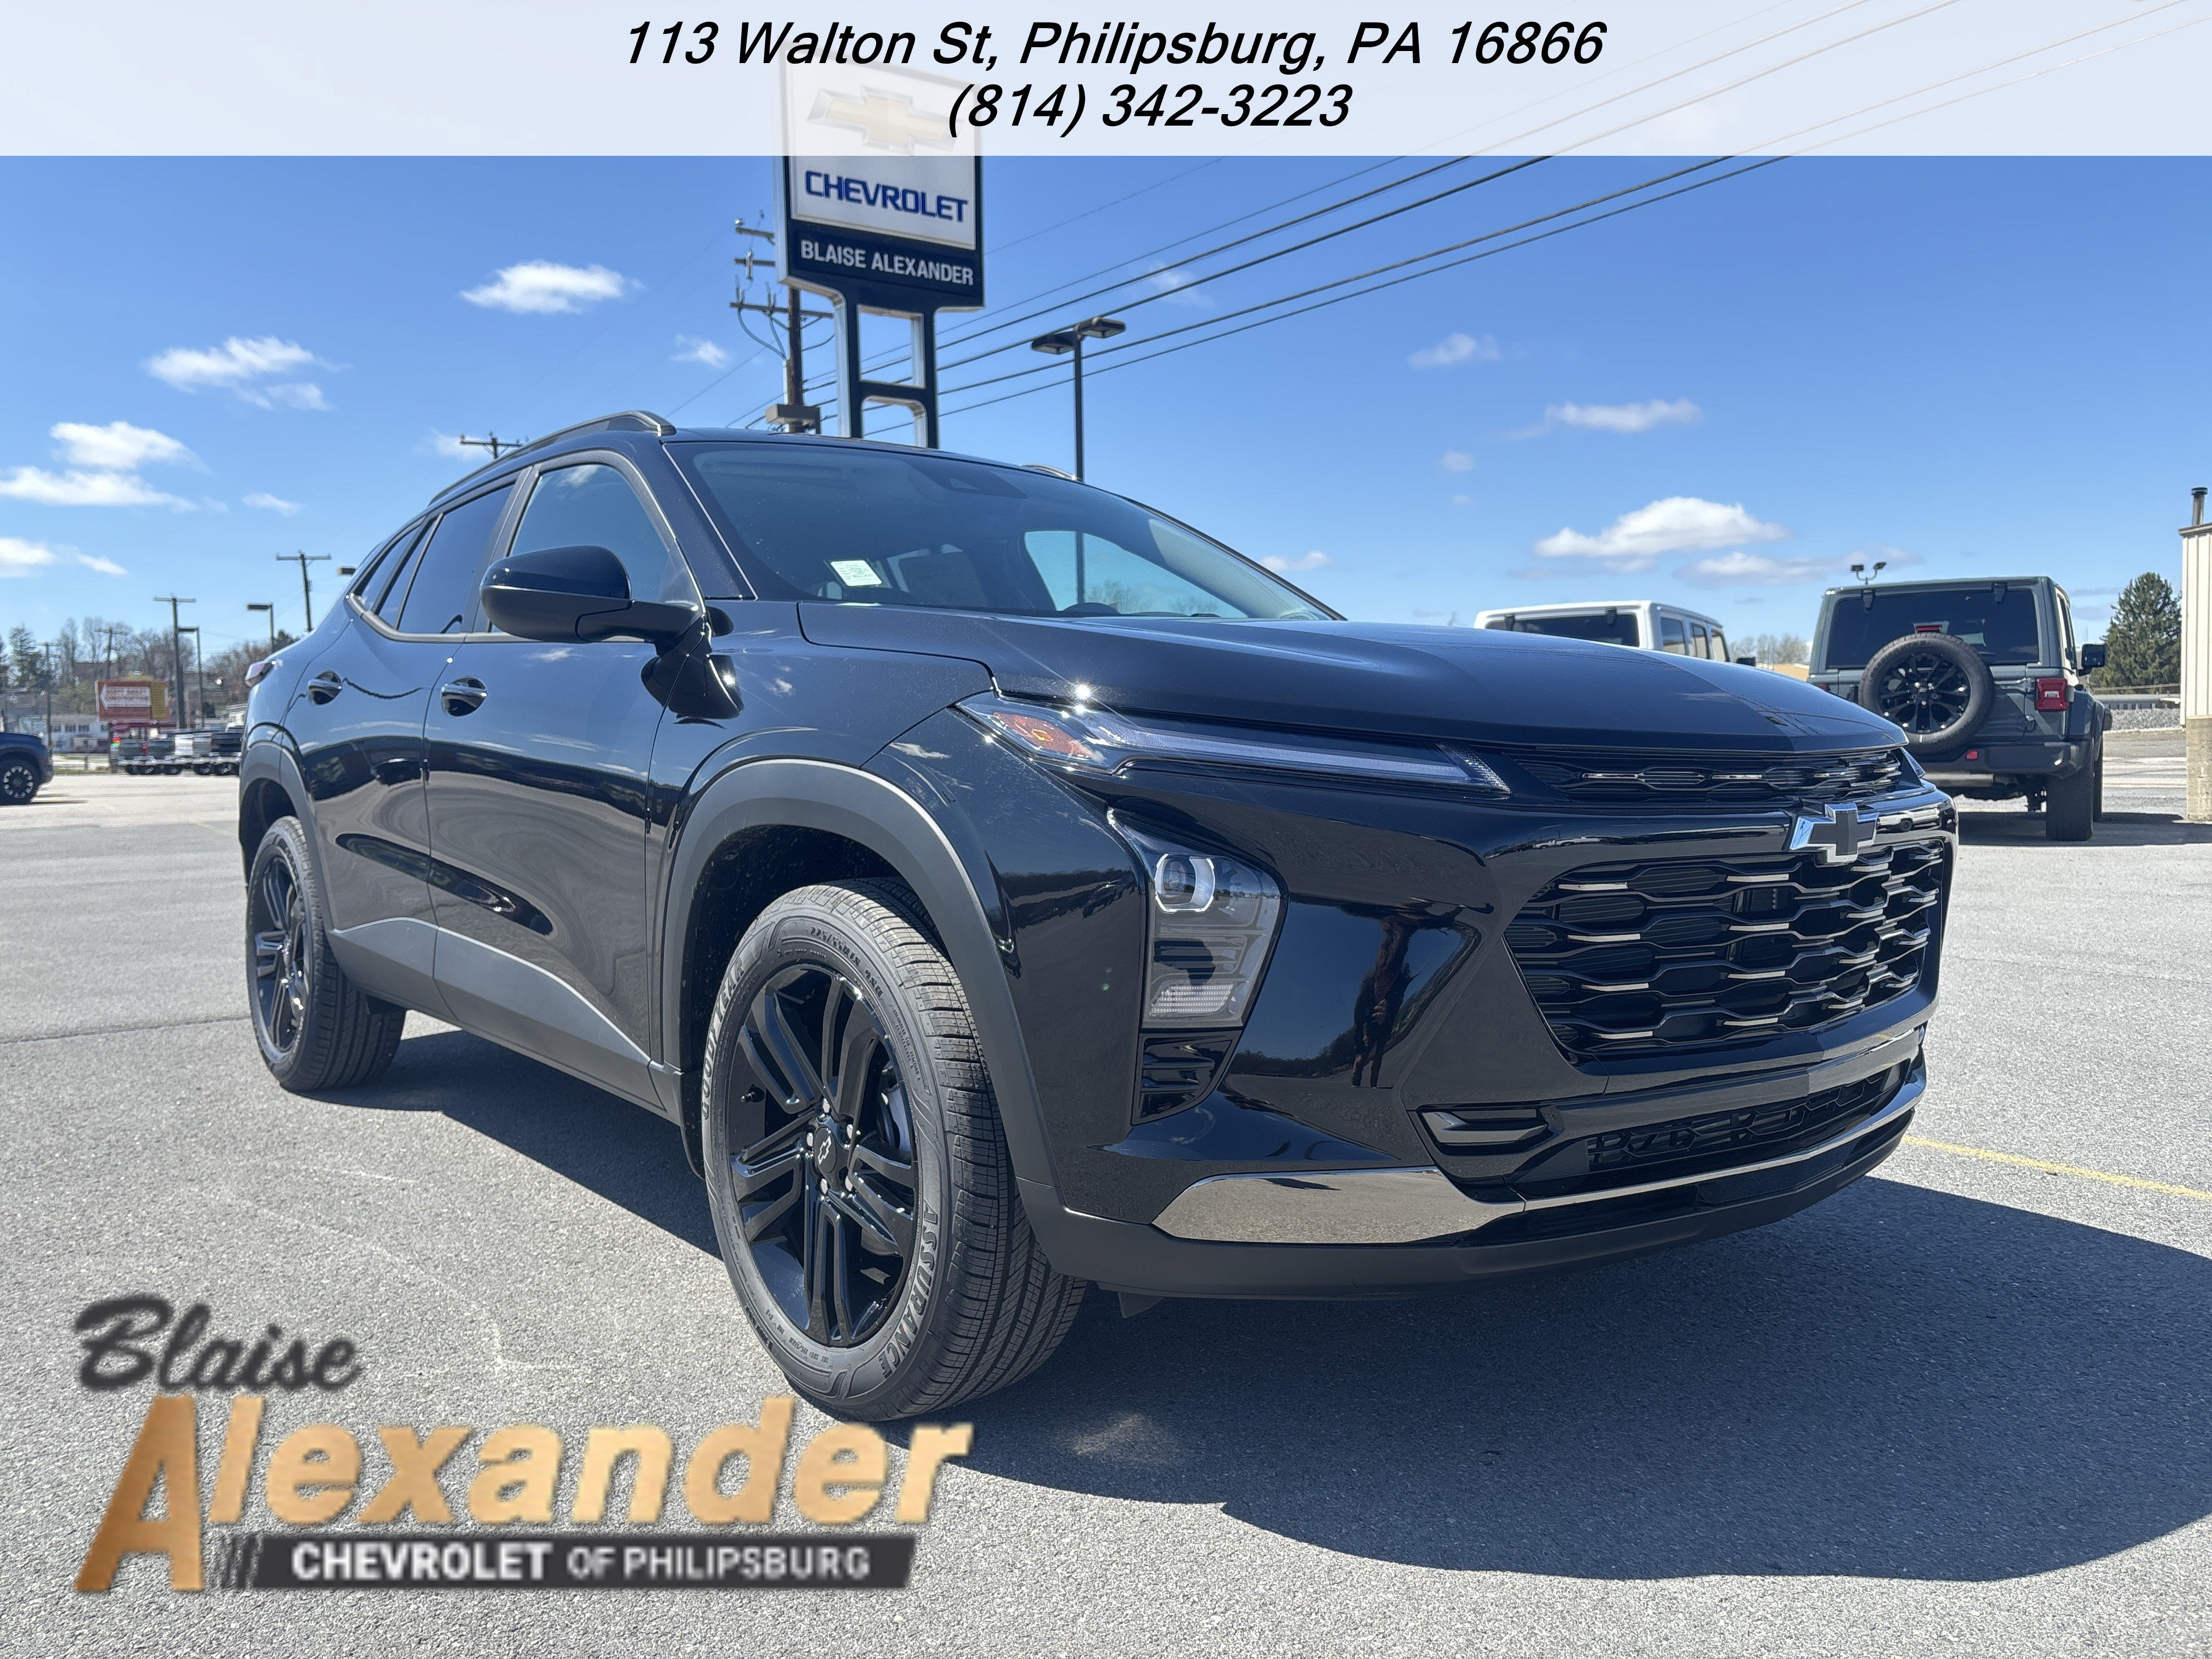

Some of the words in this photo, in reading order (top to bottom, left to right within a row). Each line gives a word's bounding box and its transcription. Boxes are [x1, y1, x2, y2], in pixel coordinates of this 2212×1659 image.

[805, 170, 968, 222] CHEVROLET
[800, 239, 867, 269] BLAISE
[871, 252, 974, 286] ALEXANDER
[702, 957, 744, 1120] GOODYEAR
[878, 1198, 939, 1379] ASSURANCE
